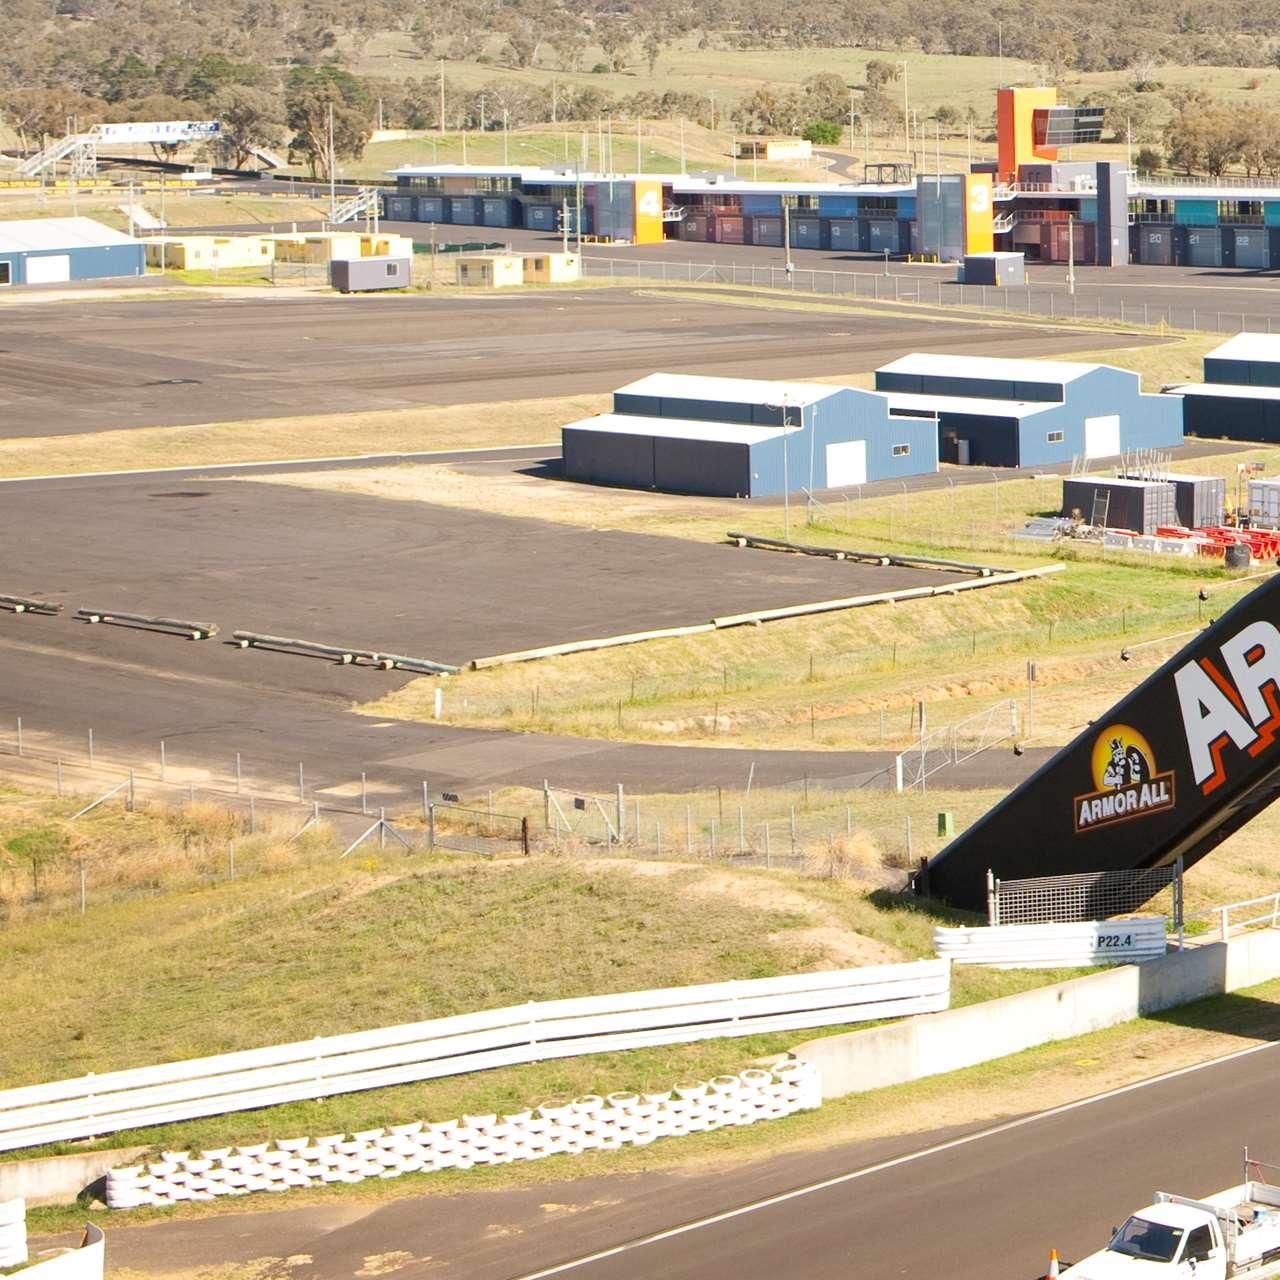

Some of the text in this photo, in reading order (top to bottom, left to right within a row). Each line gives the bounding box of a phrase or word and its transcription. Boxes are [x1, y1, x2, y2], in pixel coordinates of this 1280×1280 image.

[638, 190, 659, 217] 4
[971, 185, 989, 212] 3
[1236, 236, 1249, 246] 22
[1079, 781, 1169, 826] ARMOR ALL
[1097, 934, 1132, 948] P22.4
